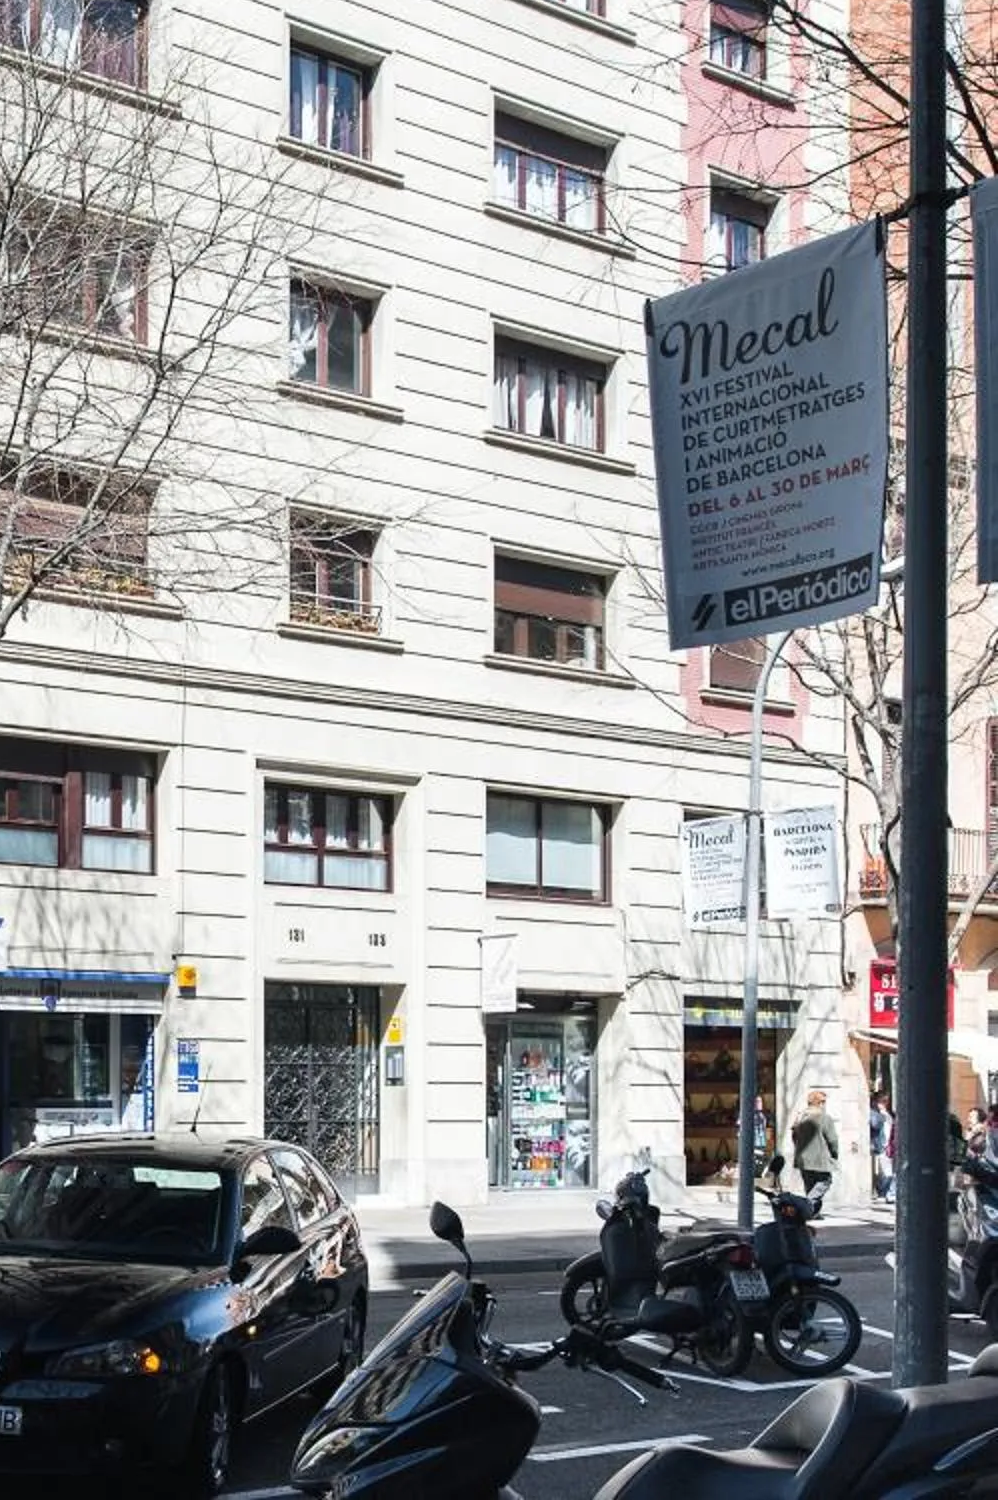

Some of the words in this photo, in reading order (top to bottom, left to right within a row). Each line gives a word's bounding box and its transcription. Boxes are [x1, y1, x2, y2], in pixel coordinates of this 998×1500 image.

[659, 266, 839, 385] Mecal
[680, 388, 709, 409] XVI
[714, 361, 794, 399] FESTIVAL
[681, 372, 830, 431] INTERNACIONAL
[683, 431, 709, 452] DE
[713, 381, 866, 443] CURTMETRATGES
[686, 474, 713, 494] DE
[716, 443, 827, 487] BARCELONA
[695, 425, 787, 471] ANIMACIÓ
[688, 496, 724, 517] DEL
[729, 493, 741, 508] 6
[745, 486, 767, 503] AL
[770, 478, 795, 497] 30
[799, 470, 822, 489] DE
[825, 453, 872, 483] MARÇ
